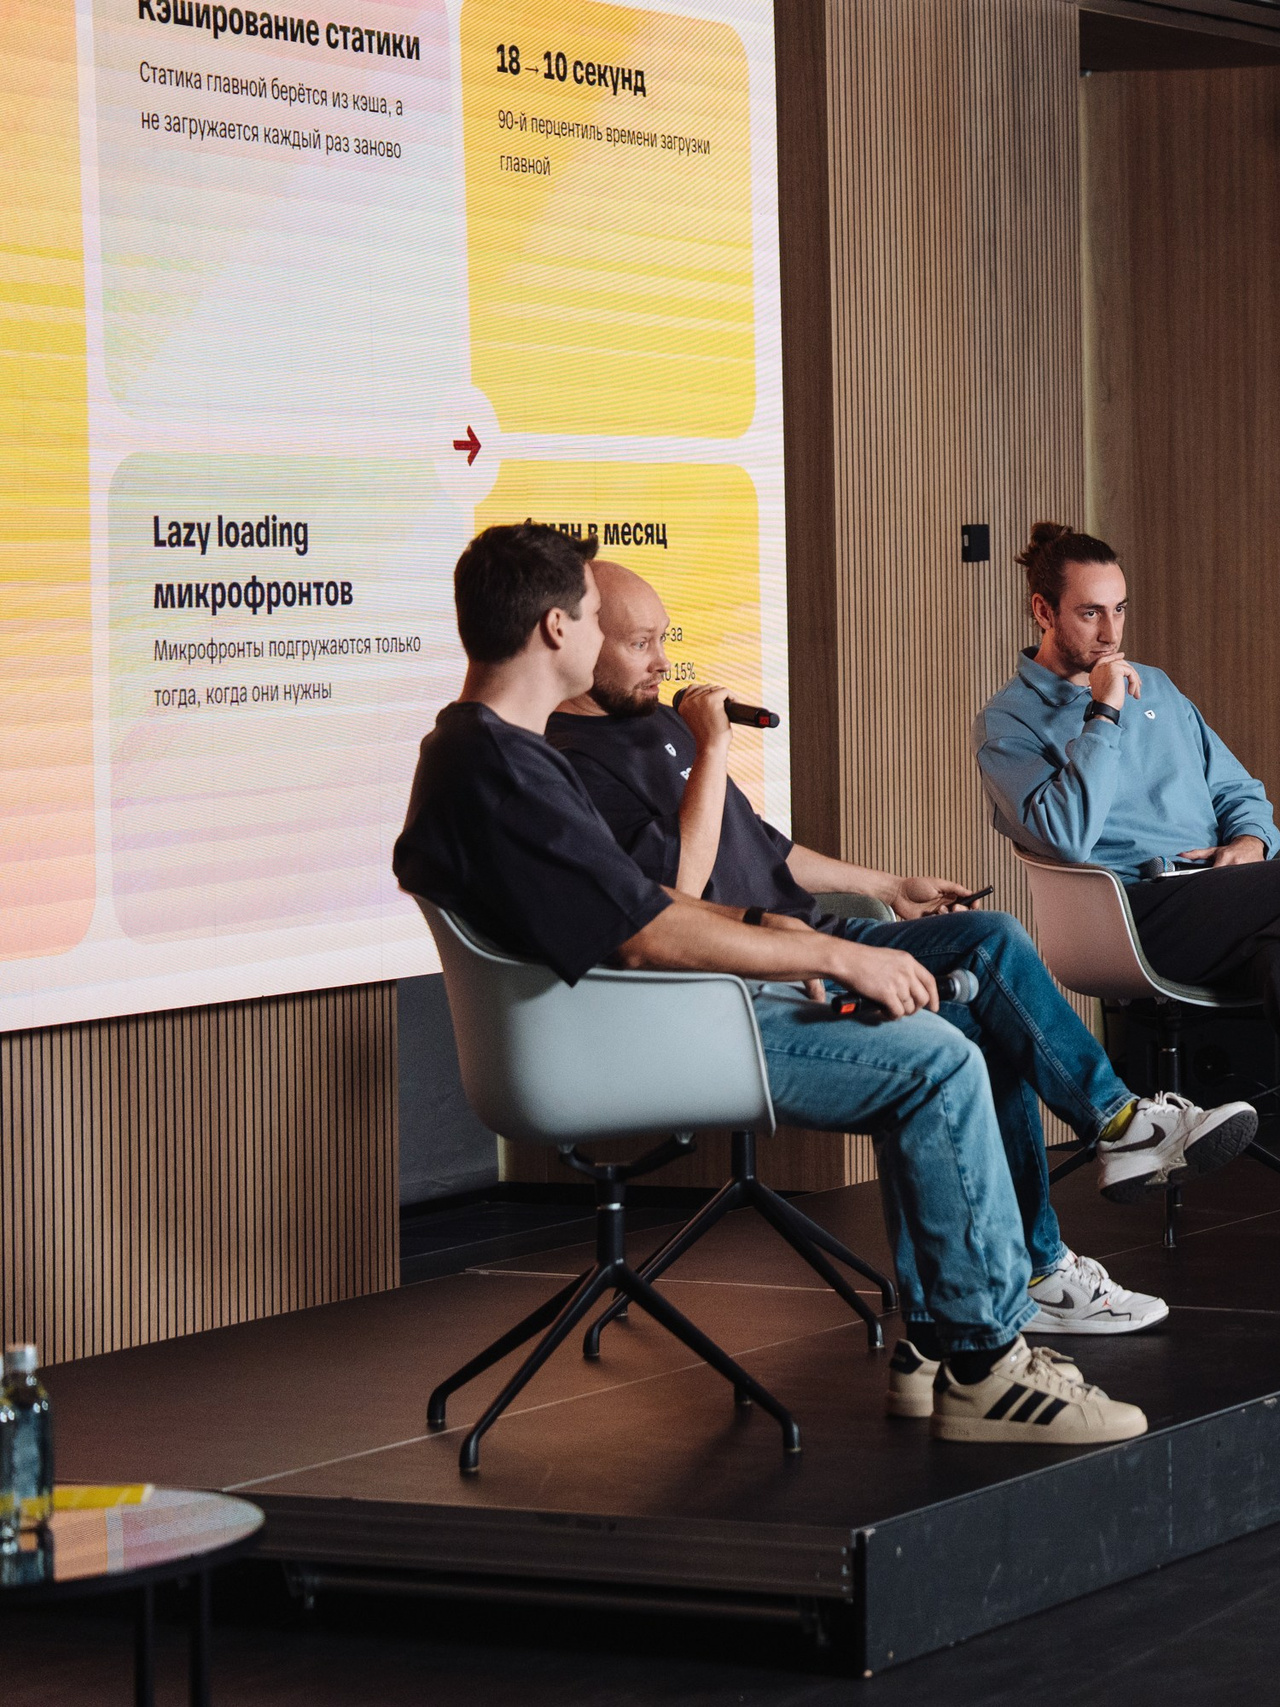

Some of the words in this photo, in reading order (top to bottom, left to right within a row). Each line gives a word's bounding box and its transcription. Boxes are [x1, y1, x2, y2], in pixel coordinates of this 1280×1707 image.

[325, 22, 420, 61] статики
[139, 61, 202, 90] Статика
[206, 74, 267, 99] главной
[271, 78, 328, 106] берётся
[332, 90, 349, 109] из
[352, 93, 392, 118] кэша,
[395, 99, 403, 116] а
[496, 44, 521, 75] 18
[543, 51, 568, 82] 10
[573, 60, 647, 97] секунд
[141, 111, 160, 130] не
[164, 114, 259, 142] загружается
[263, 126, 321, 150] каждый
[325, 132, 350, 155] раз
[353, 136, 402, 159] заново
[498, 110, 528, 132] 90-й
[530, 116, 603, 141] перцентиль
[606, 126, 658, 148] времени
[660, 133, 711, 156] загрузки
[500, 154, 551, 176] главной
[153, 515, 211, 555] Lazy
[217, 514, 309, 556] loading
[603, 522, 667, 549] месяц
[153, 575, 353, 616] микрофронтов
[153, 637, 264, 665] Микрофронты
[268, 636, 371, 661] подгружаются
[375, 636, 421, 653] только
[674, 662, 696, 681] 15%
[154, 687, 201, 709] тогда,
[206, 685, 248, 707] когда
[251, 684, 279, 702] они
[283, 682, 332, 705] нужны
